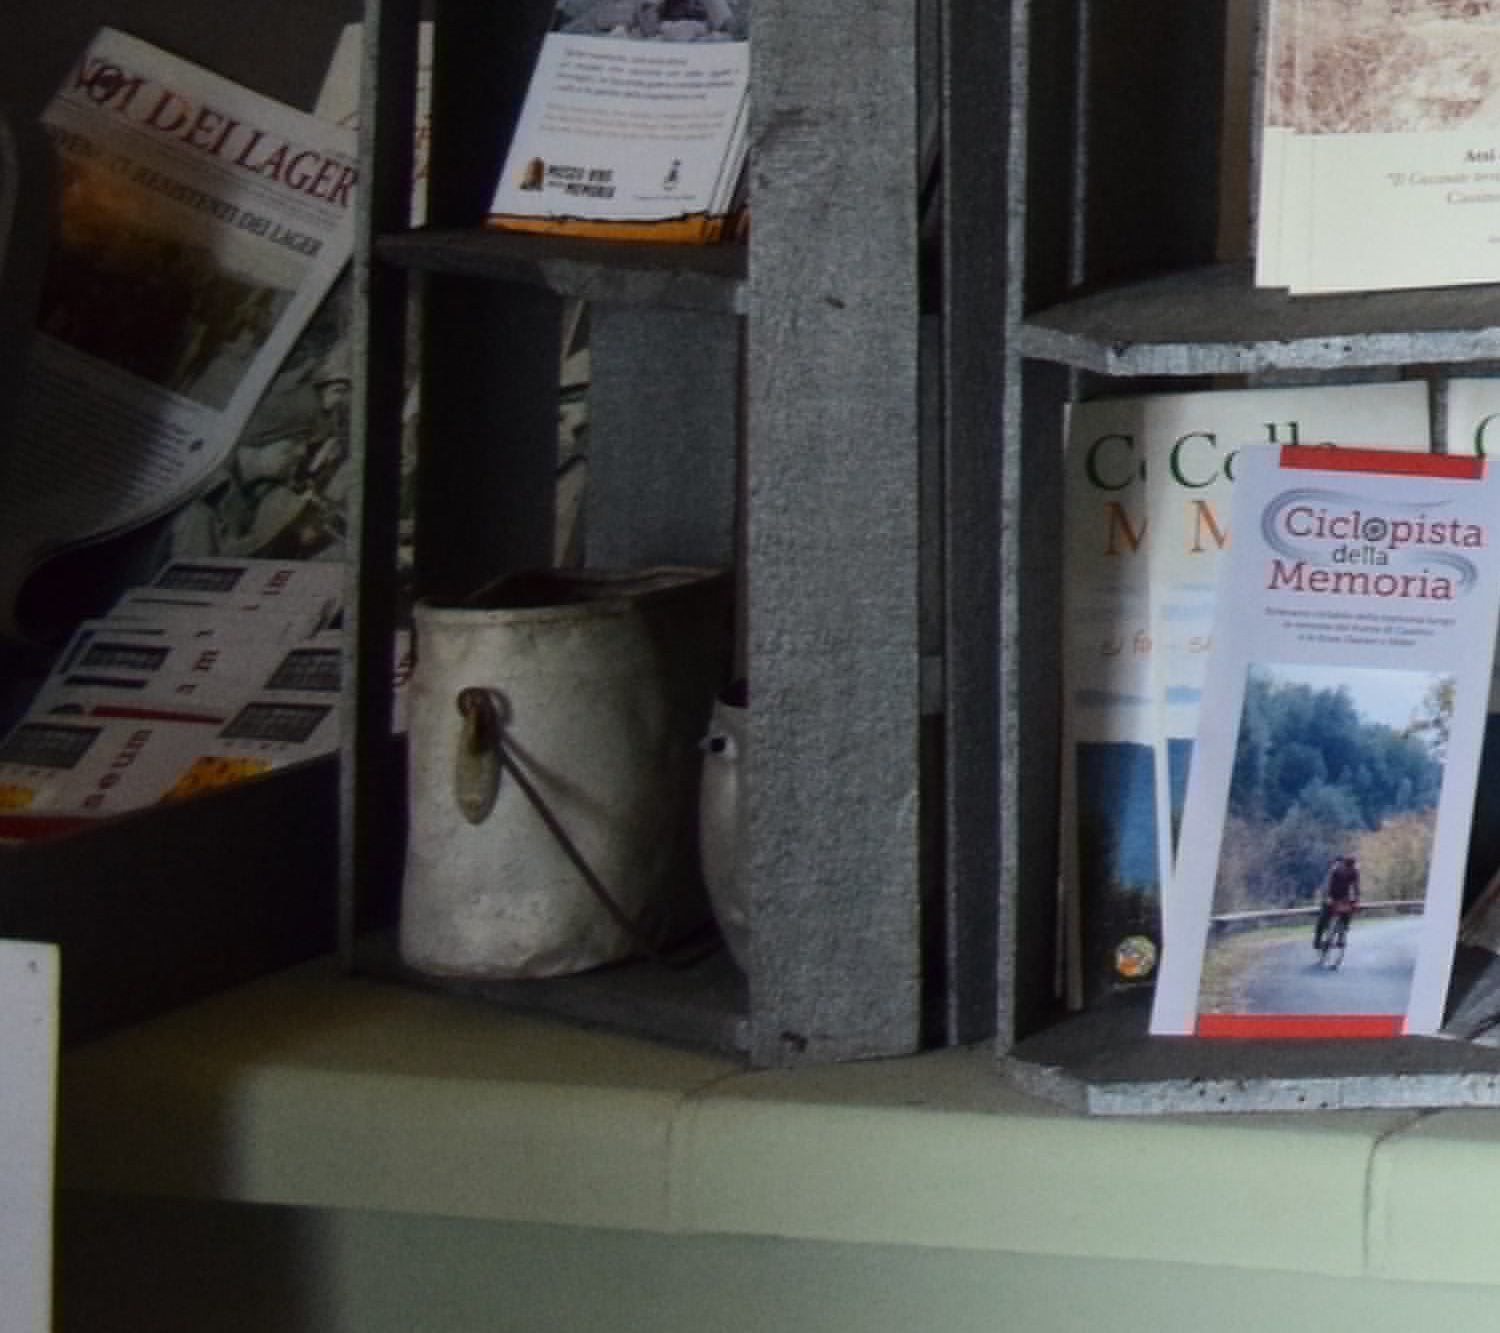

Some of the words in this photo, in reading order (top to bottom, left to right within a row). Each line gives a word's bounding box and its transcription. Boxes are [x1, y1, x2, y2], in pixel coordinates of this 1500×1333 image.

[145, 90, 241, 157] DEI
[232, 129, 359, 211] LAGER
[238, 210, 272, 237] DEI
[269, 223, 324, 259] LAGER
[1284, 506, 1482, 550] Ciclopista
[1332, 544, 1389, 566] della
[1266, 559, 1453, 600] Memoria
